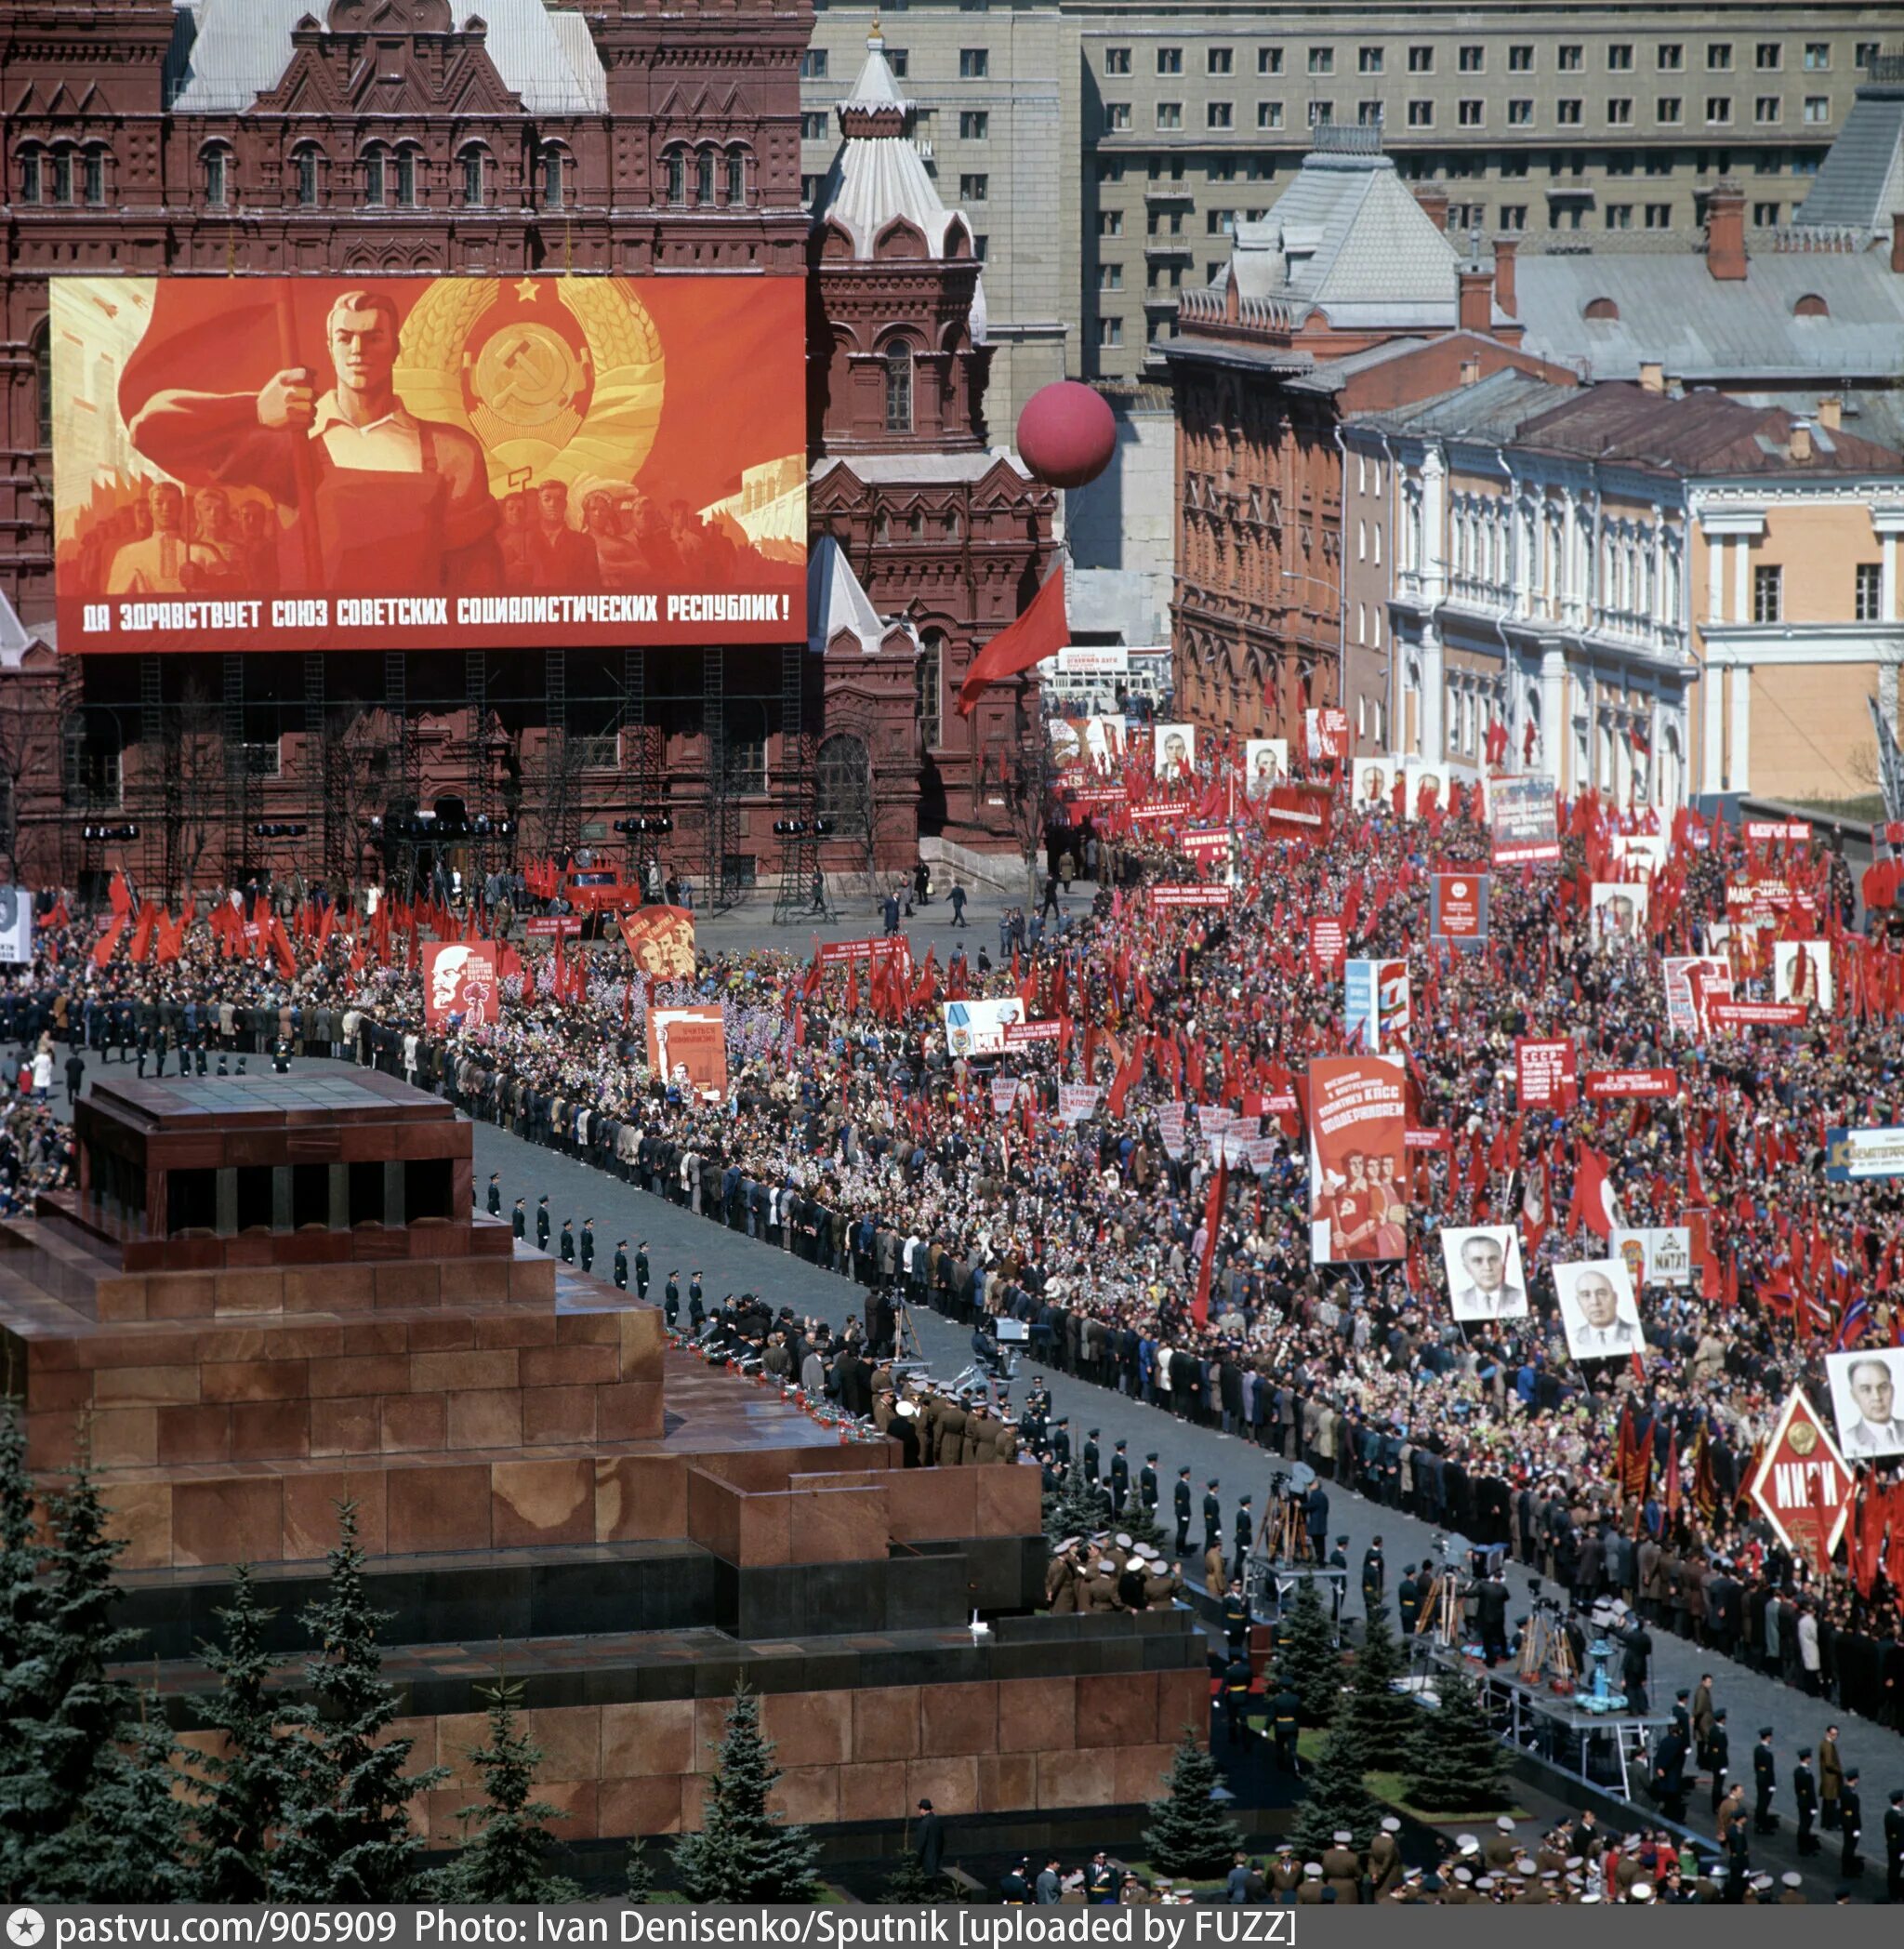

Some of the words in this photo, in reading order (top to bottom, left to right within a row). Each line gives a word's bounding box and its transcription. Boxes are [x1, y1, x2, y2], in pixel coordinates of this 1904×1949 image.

[83, 603, 111, 632] ДА
[119, 601, 263, 631] ЗДРАВСТВУЕТ
[271, 599, 328, 628] СОЮЗ
[337, 597, 448, 627] СОВЕТСКИХ
[456, 595, 658, 625] СОЦИАЛИСТИЧЕСКИХ
[1523, 1068, 1563, 1077] ЛЕНИНСОЙ
[1069, 1087, 1096, 1096] СЛАВА
[1318, 1092, 1363, 1119] ПОЛИТИКУ
[1364, 1085, 1399, 1102] КПСС
[1320, 1101, 1405, 1135] ПОДДЕРЖИВАЕМ
